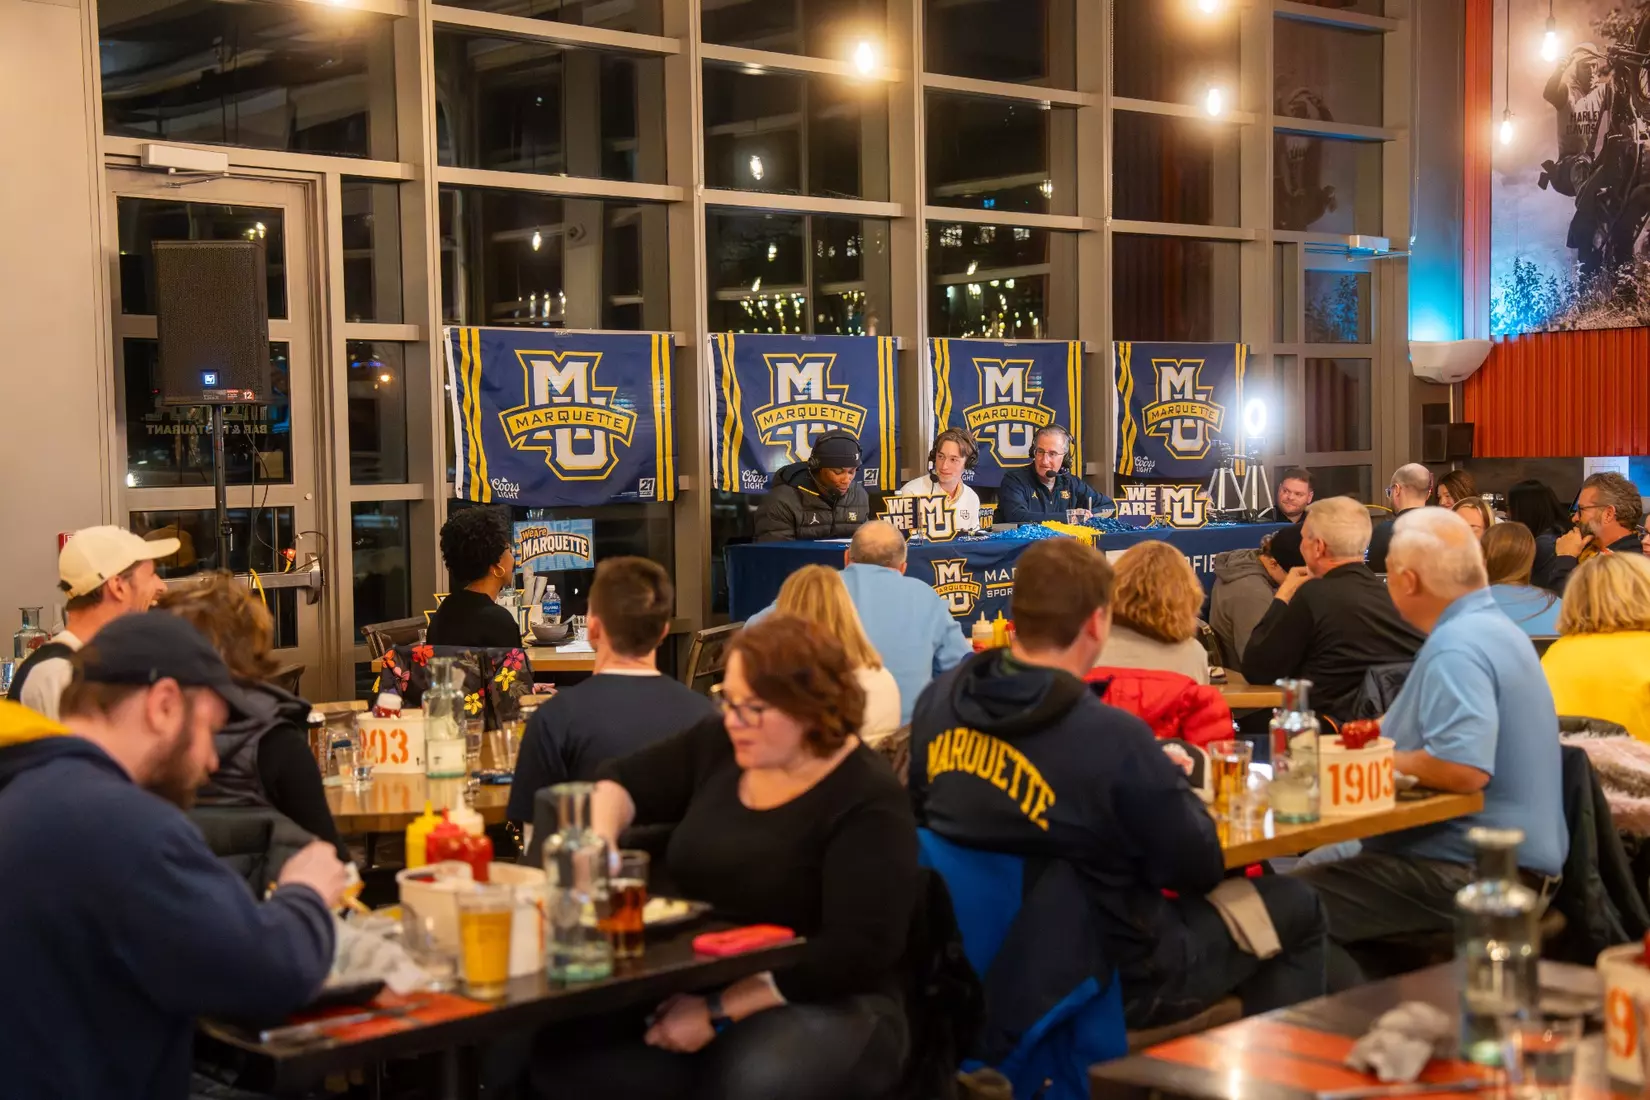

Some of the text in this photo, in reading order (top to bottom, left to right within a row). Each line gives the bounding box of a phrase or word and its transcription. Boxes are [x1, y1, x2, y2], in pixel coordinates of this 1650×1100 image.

[243, 391, 253, 399] 12
[516, 410, 623, 429] MARQUETTE
[763, 407, 855, 426] MARQUETTE
[972, 407, 1045, 424] MARQUETTE
[1151, 404, 1216, 420] MARQUETTE
[1134, 456, 1155, 468] Coors
[742, 469, 768, 482] Coors
[865, 470, 877, 480] 21
[491, 478, 520, 492] Coors
[640, 479, 654, 491] 21
[744, 481, 764, 490] LIGHT
[497, 490, 520, 500] LIGHT
[1126, 487, 1157, 501] WE
[886, 498, 913, 514] WE
[1119, 501, 1157, 516] ARE
[1162, 487, 1204, 525] MU
[920, 497, 952, 539] MU
[522, 535, 588, 560] MARQUETTE
[1327, 757, 1394, 806] 1903
